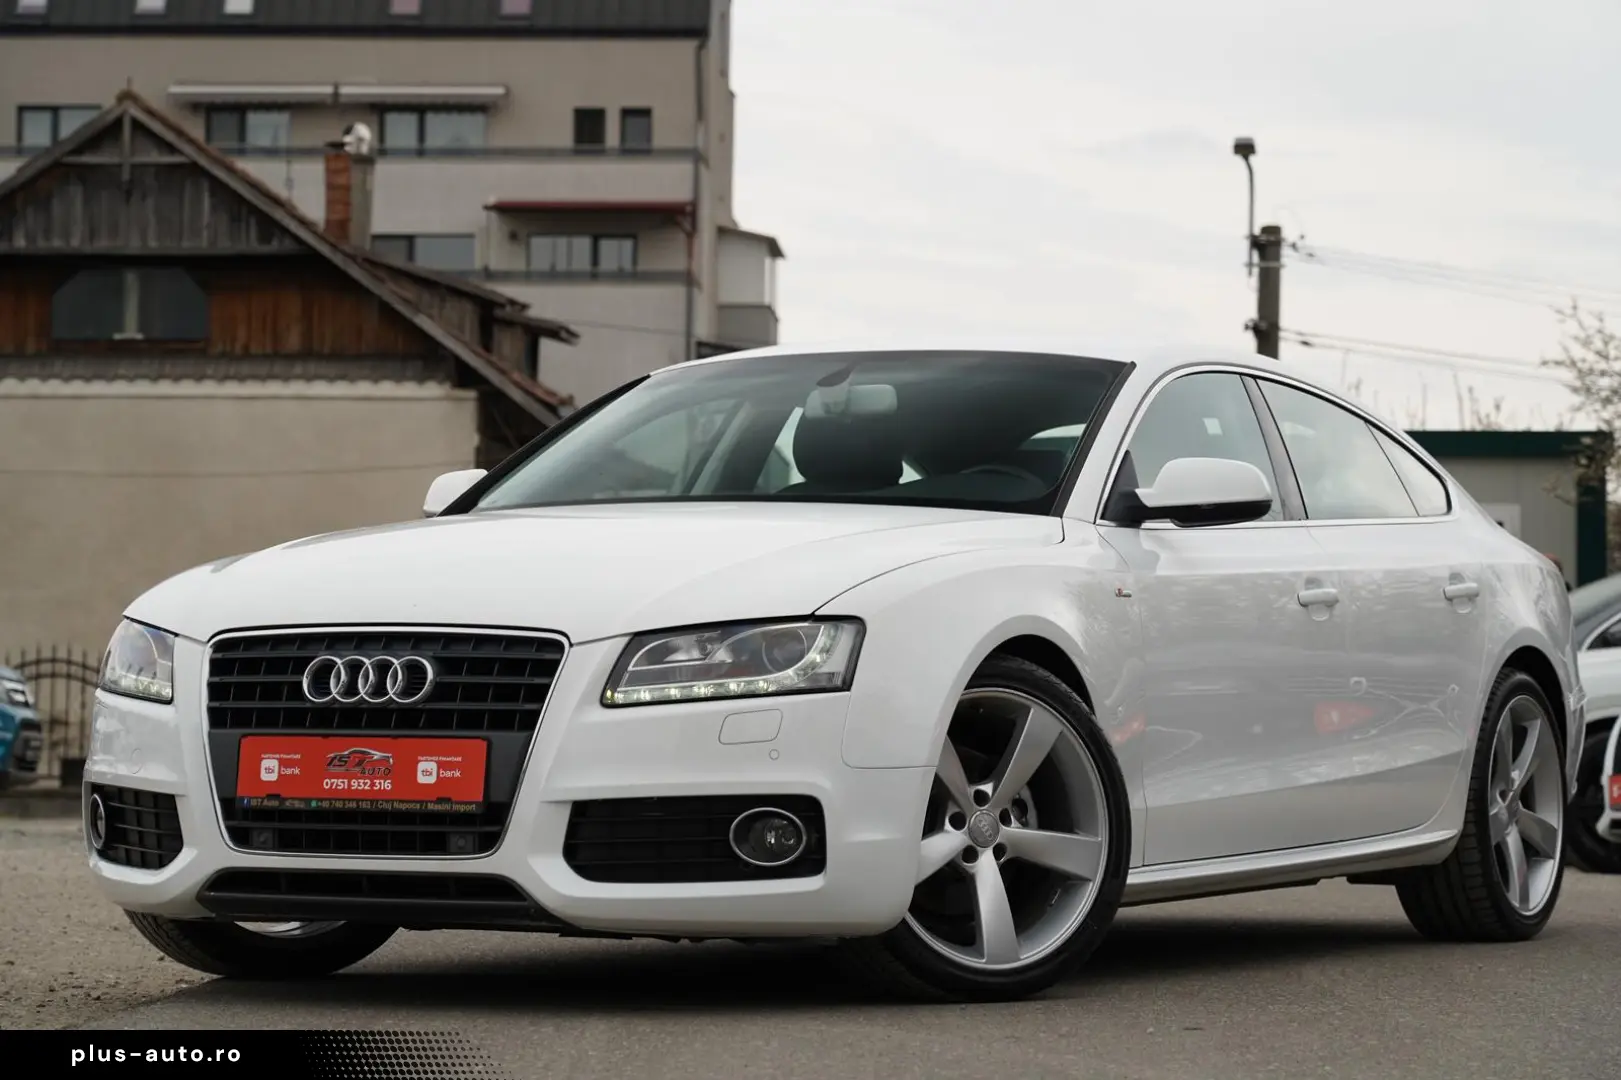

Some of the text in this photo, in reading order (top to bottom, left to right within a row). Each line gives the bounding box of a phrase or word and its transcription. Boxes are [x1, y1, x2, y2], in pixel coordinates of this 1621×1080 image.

[280, 765, 301, 775] bank
[360, 767, 391, 776] AUTO
[421, 767, 461, 778] tbi bank
[323, 778, 392, 790] 0751 932 316
[377, 801, 392, 810] Cluj
[393, 801, 420, 810] Napoca
